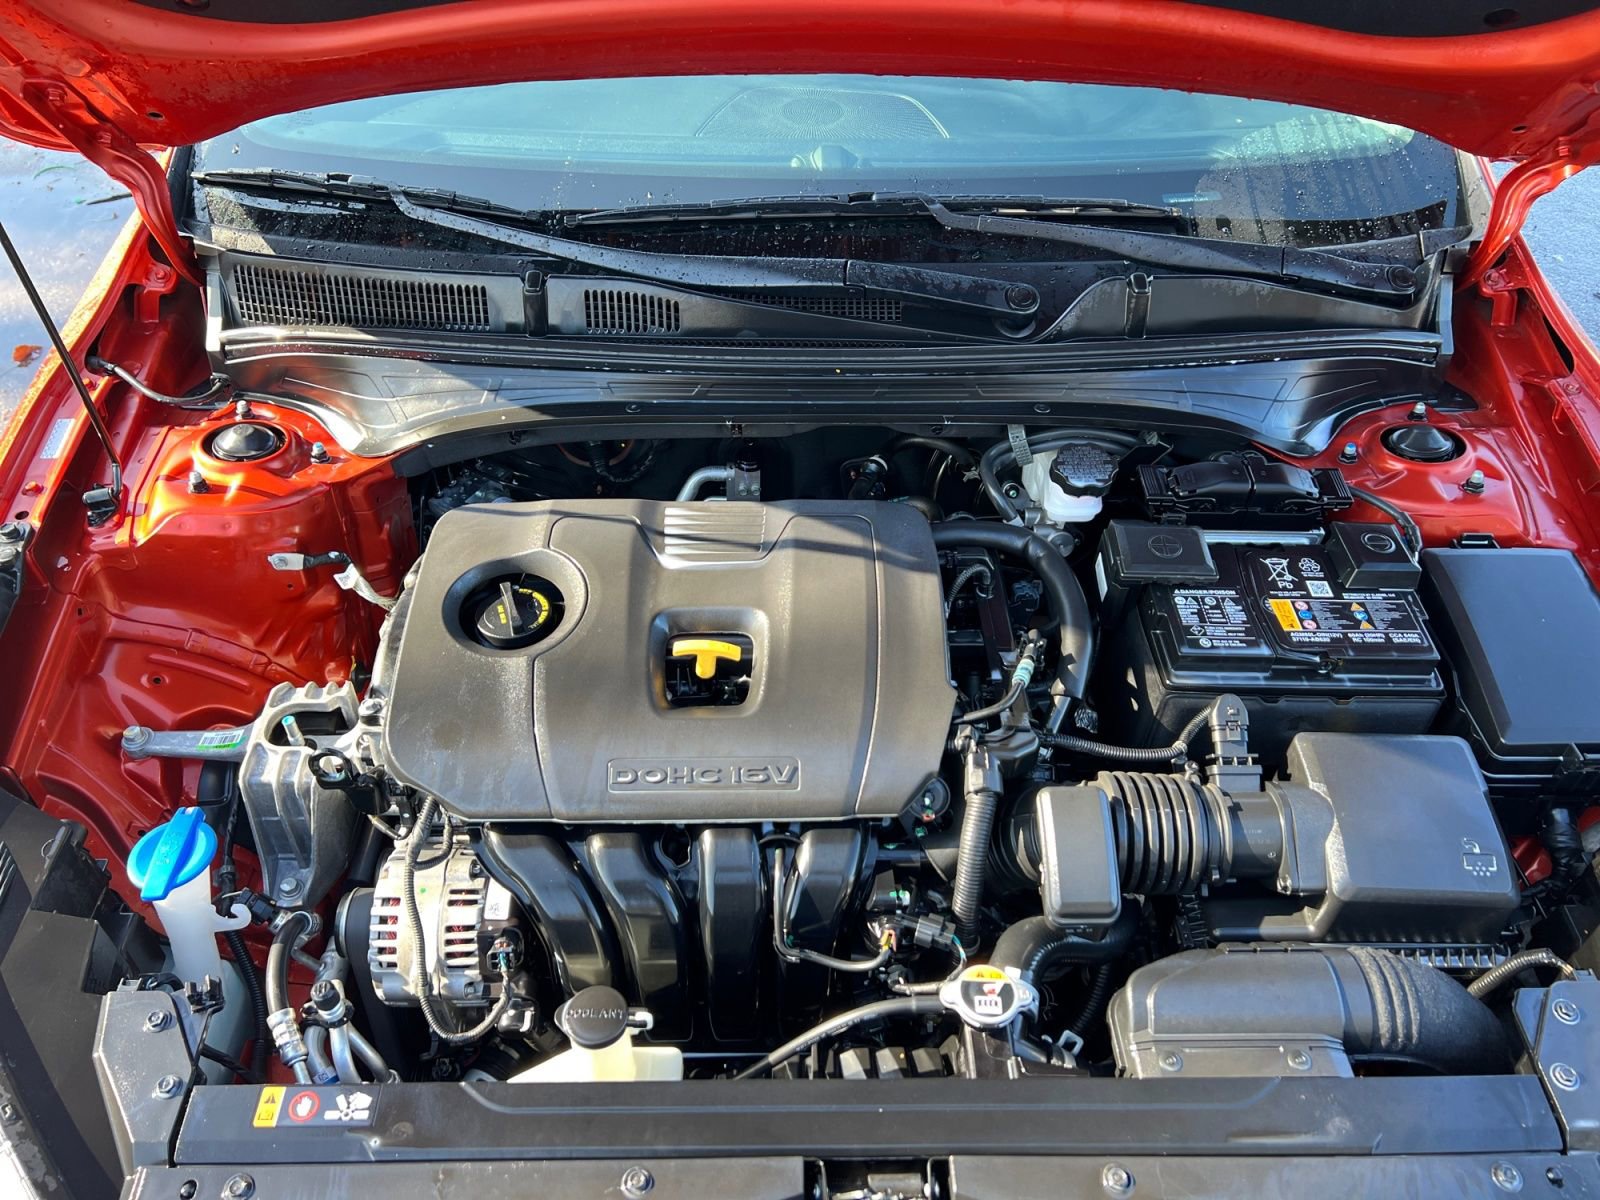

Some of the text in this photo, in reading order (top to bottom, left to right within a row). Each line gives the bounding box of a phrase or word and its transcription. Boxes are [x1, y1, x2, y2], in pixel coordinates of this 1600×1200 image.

[1278, 581, 1293, 589] Pb
[610, 765, 798, 785] DOHC 16V
[565, 1008, 624, 1020] COOLANT
